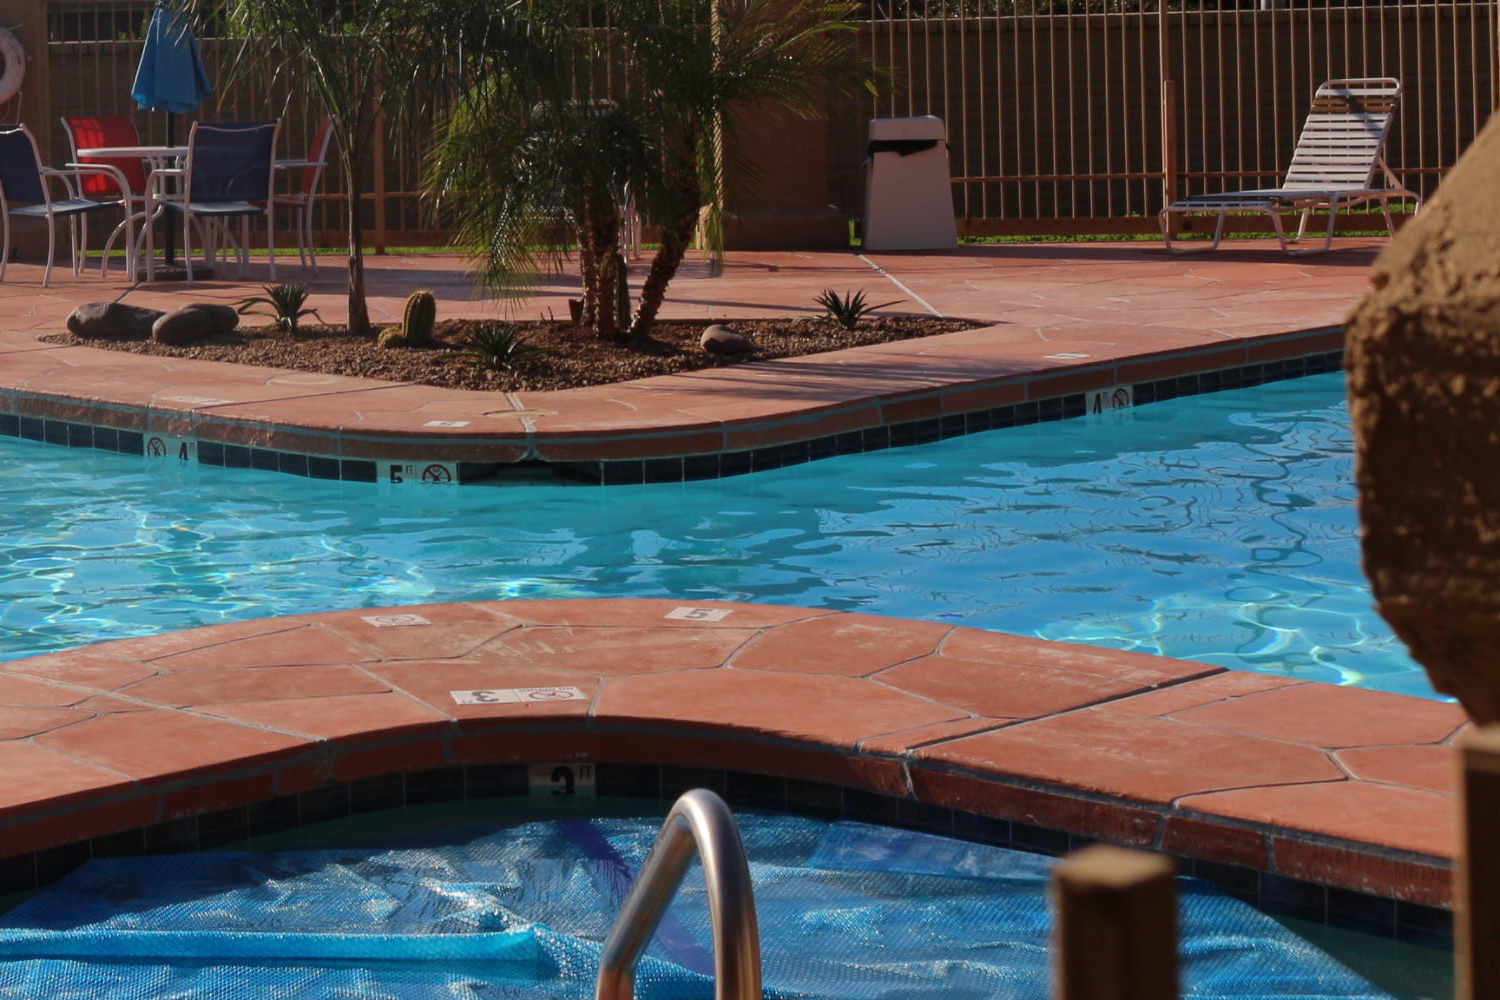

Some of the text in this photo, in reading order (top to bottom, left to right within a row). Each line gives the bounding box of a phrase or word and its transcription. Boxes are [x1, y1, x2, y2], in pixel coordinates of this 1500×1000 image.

[389, 464, 404, 484] 5
[684, 608, 713, 619] 5
[471, 690, 500, 703] 3
